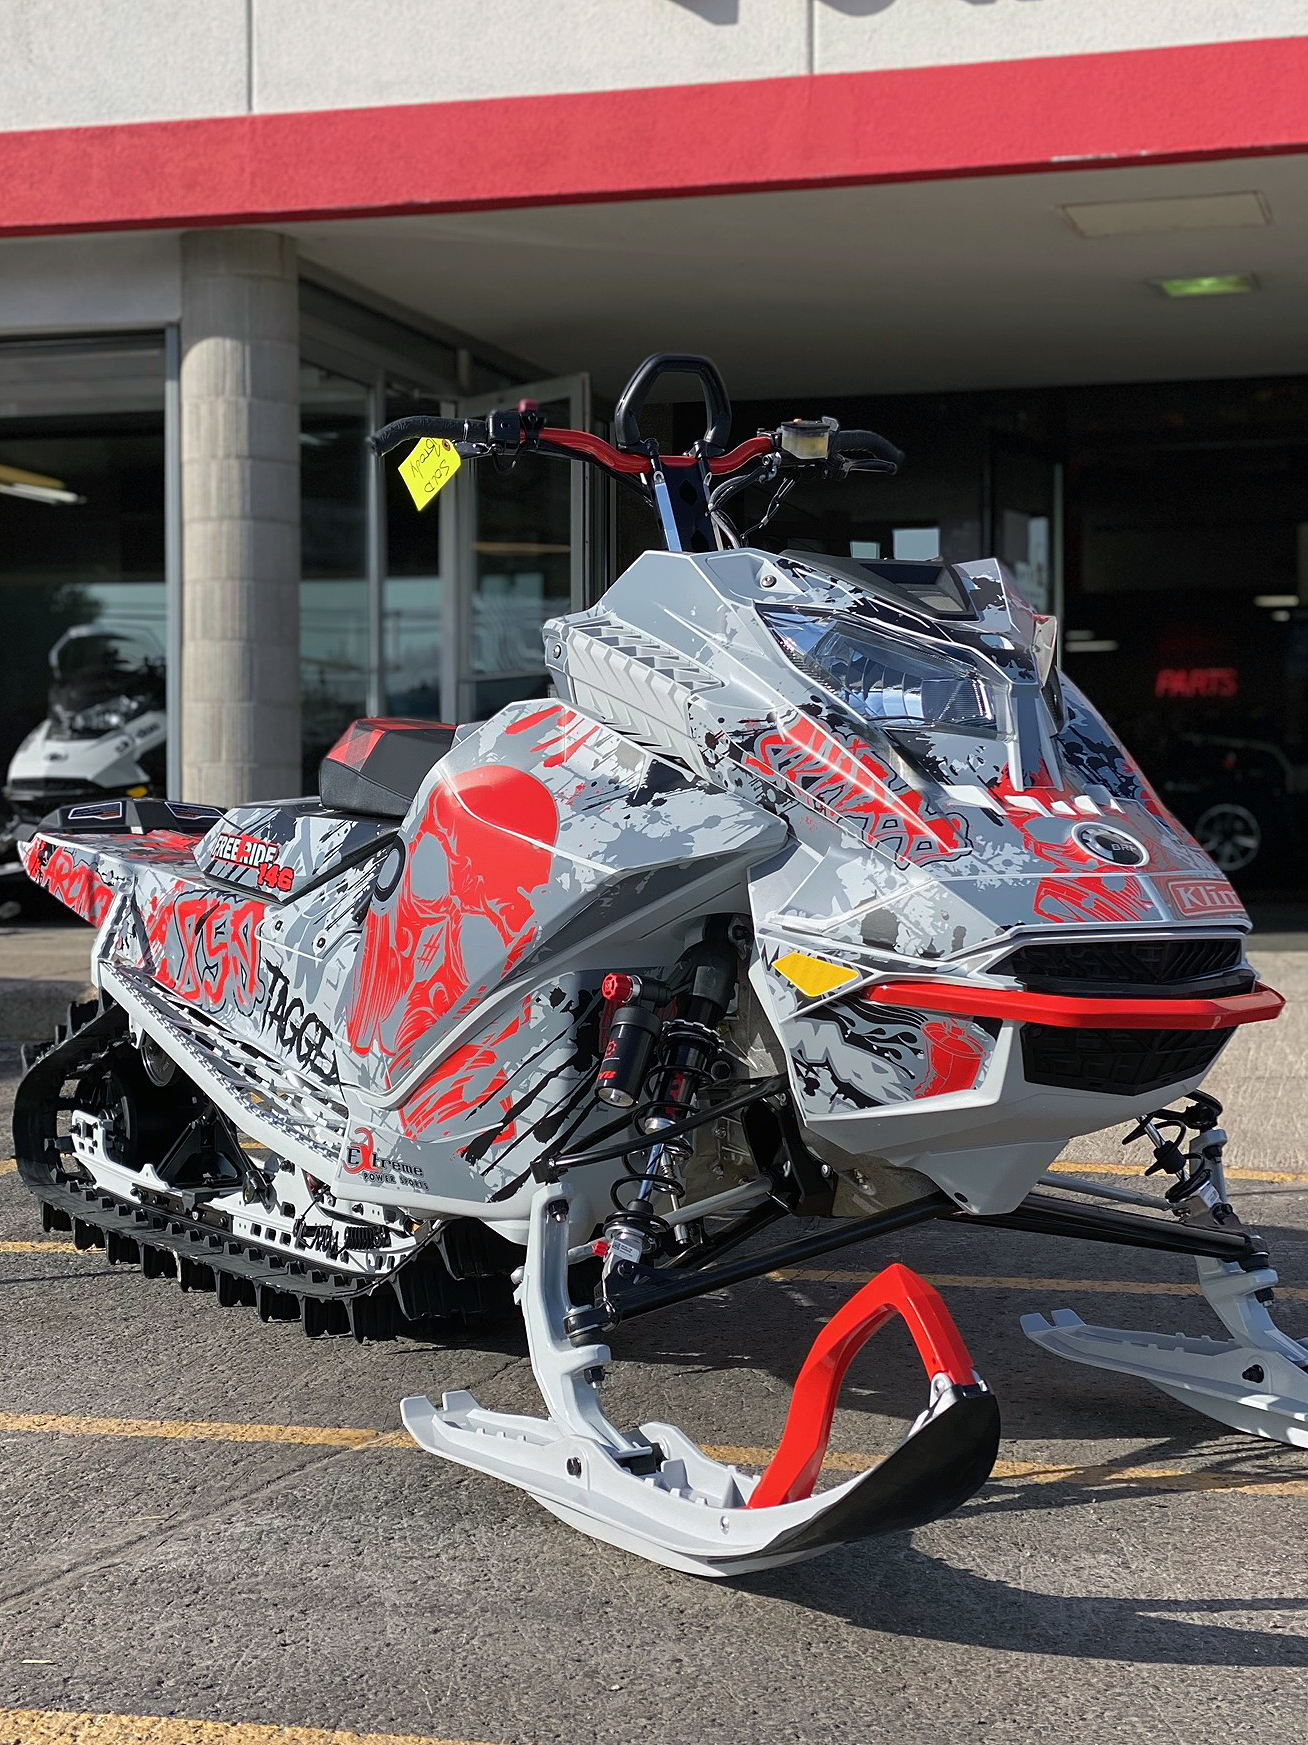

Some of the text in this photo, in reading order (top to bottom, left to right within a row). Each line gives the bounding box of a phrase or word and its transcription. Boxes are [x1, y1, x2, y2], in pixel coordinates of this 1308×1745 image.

[424, 459, 450, 493] SOLD
[1155, 667, 1239, 698] PARTS
[257, 862, 295, 892] 146
[363, 1172, 429, 1191] POWER SPORTS
